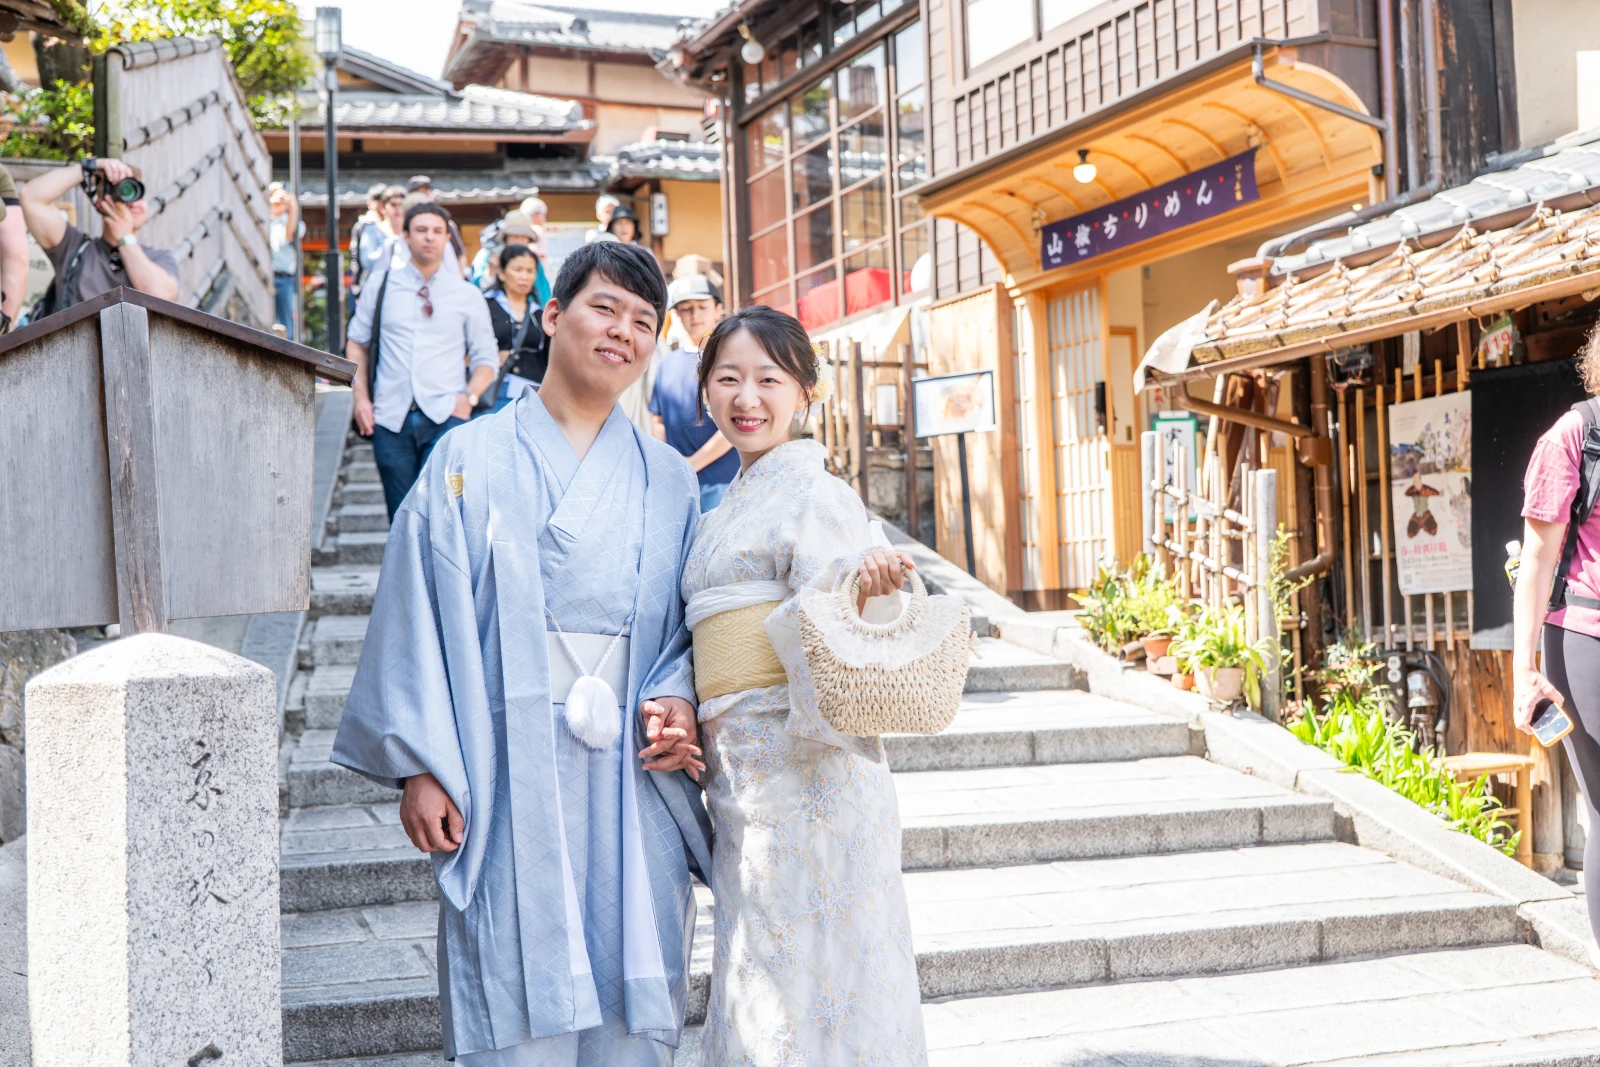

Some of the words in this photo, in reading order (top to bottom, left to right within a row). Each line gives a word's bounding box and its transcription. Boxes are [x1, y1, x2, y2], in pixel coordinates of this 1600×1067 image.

[1047, 180, 1213, 256] 山椒ちりめん
[1483, 331, 1511, 354] 119
